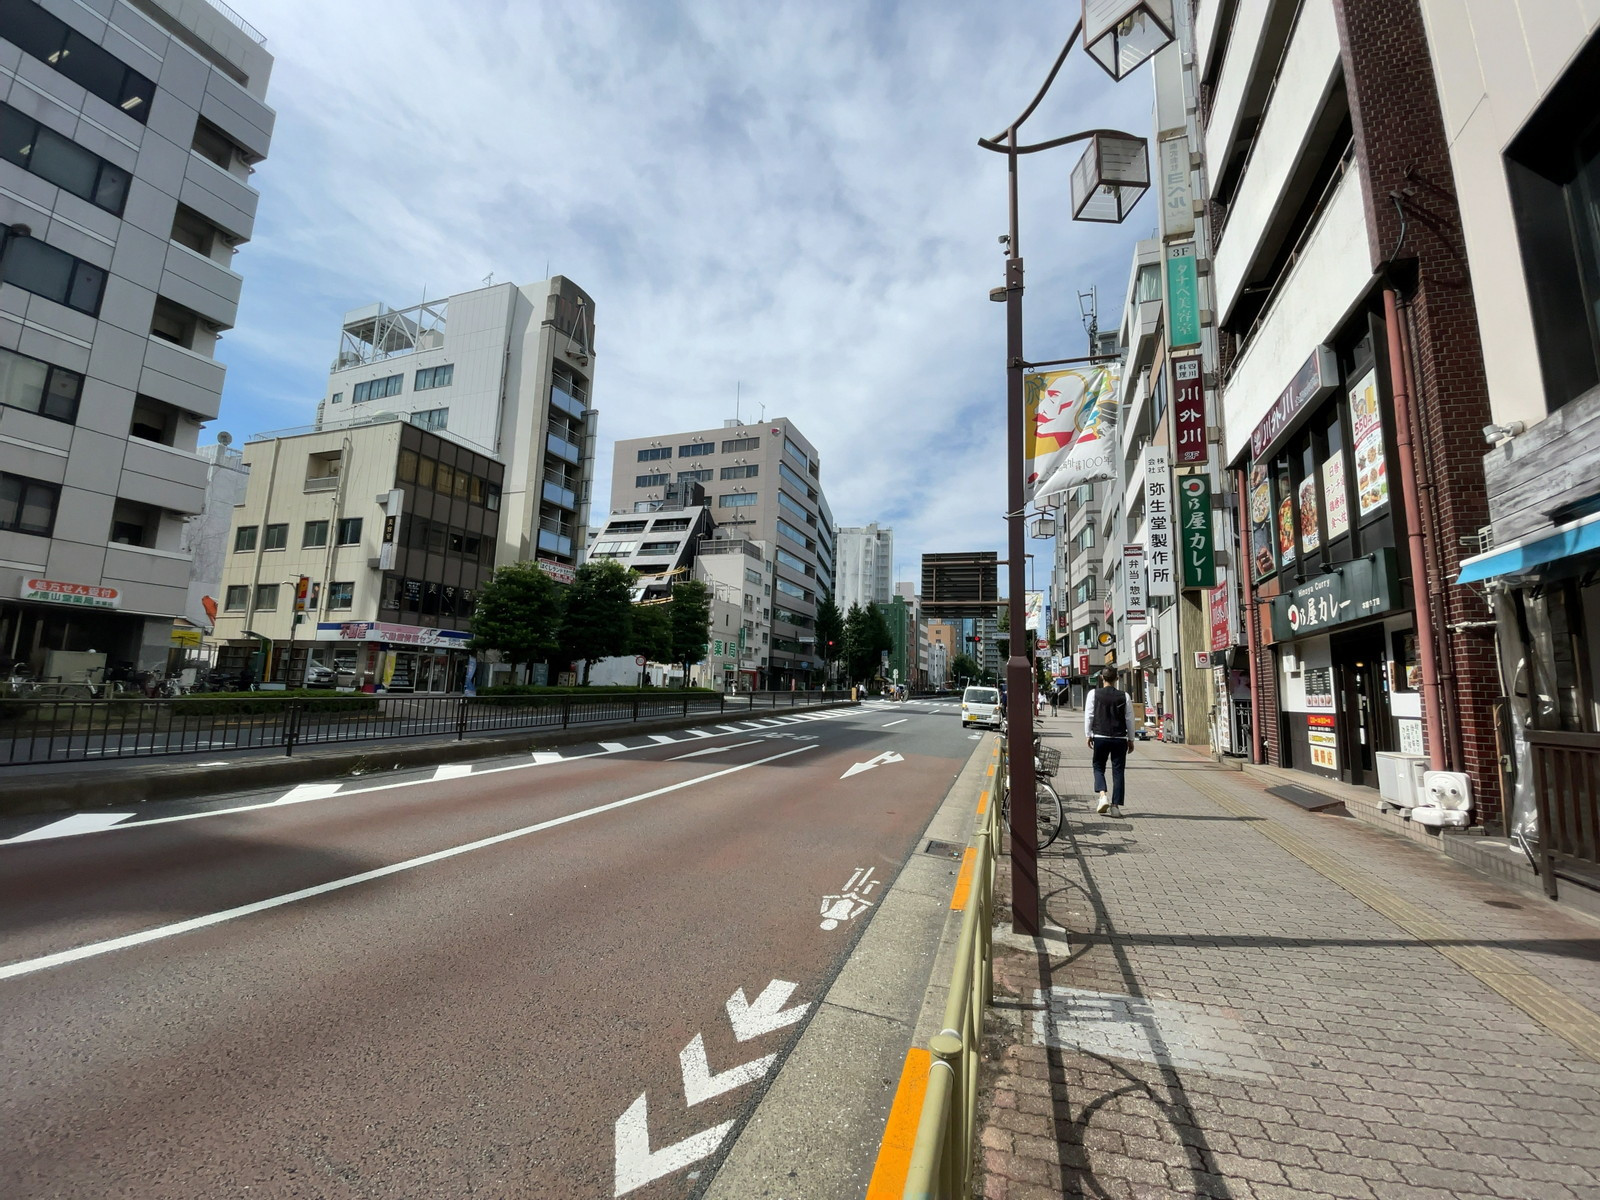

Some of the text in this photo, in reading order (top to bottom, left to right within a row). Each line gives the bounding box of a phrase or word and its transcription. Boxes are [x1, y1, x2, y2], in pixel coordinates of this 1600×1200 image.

[1173, 247, 1190, 257] 3F
[1178, 386, 1202, 444] 川外川
[1262, 386, 1294, 447] 川外川
[1184, 450, 1199, 460] 2F
[1149, 482, 1169, 583] 弥生堂製作所
[35, 581, 112, 598] 処方せん受付
[1128, 559, 1141, 606] 弁当・惣菜
[1315, 579, 1330, 590] Curry
[340, 623, 368, 640] 不動産
[714, 640, 736, 658] 薬局
